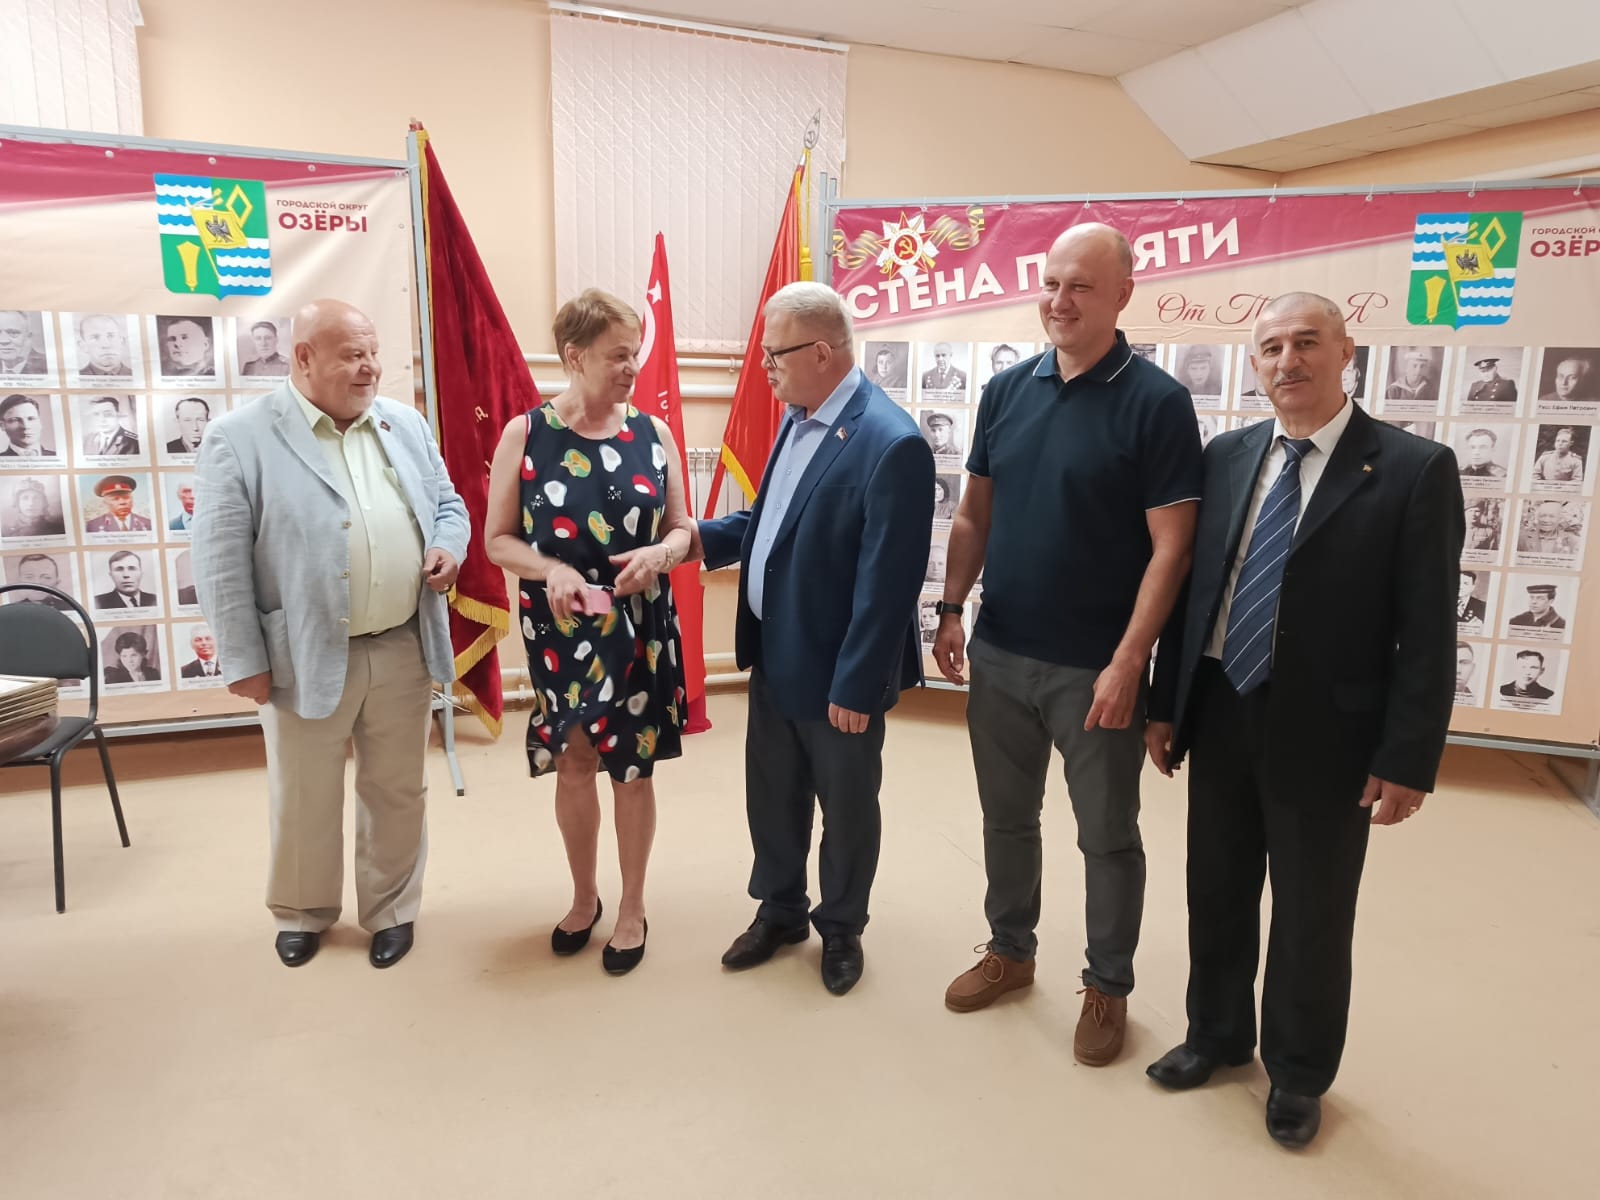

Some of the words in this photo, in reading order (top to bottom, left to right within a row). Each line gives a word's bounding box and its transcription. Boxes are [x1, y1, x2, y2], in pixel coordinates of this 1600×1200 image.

[276, 199, 337, 210] ГОРОДСКОЙ
[338, 203, 368, 211] ОКРУГ
[278, 209, 368, 233] ОЗЁРЫ
[1531, 226, 1596, 235] ГОРОДСКОЙ
[1530, 235, 1600, 258] ОЗЁР
[847, 262, 1005, 319] СТЕНА
[1015, 217, 1239, 291] ПЯТИ
[1157, 292, 1206, 324] От
